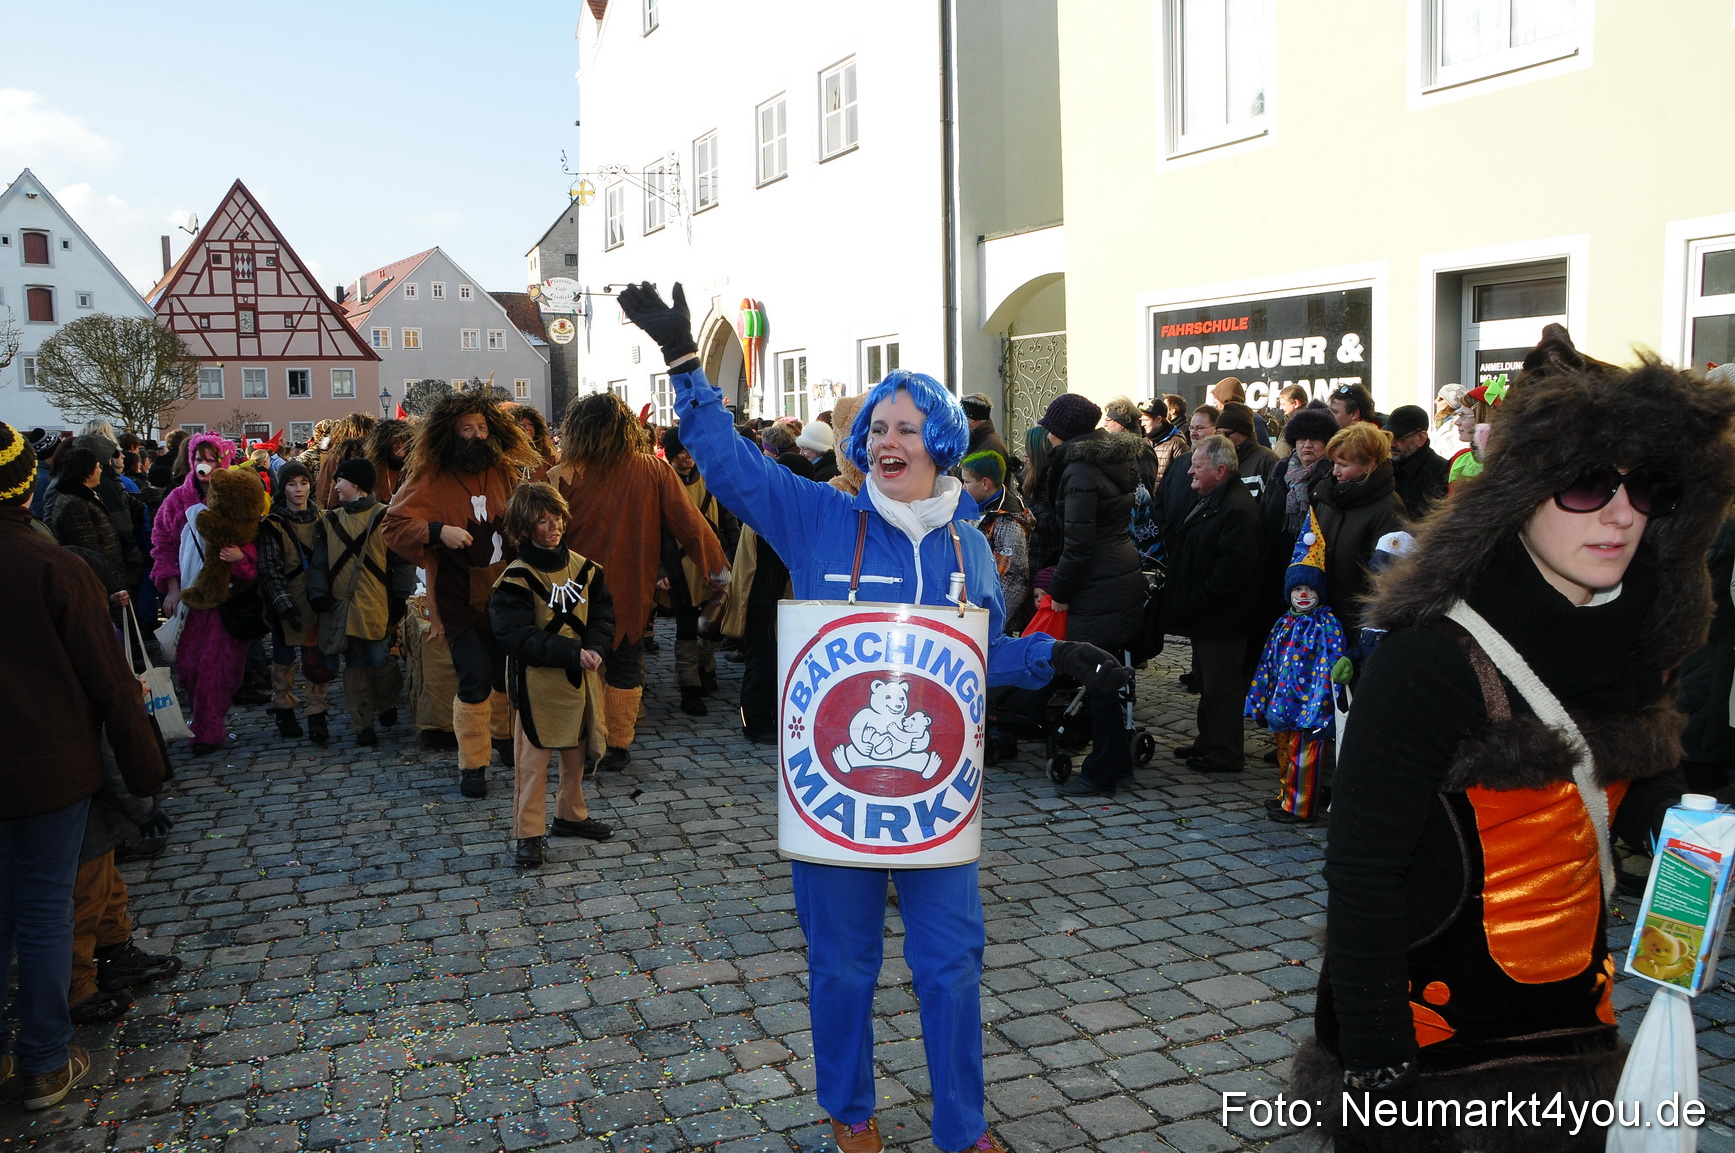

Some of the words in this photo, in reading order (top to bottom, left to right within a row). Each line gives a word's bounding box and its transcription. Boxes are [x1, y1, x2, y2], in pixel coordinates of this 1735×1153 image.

[1160, 317, 1250, 337] FAHRSCHULE
[1160, 336, 1328, 375] HOFBAUER
[1336, 332, 1365, 364] &
[1205, 376, 1362, 410] CHAN
[790, 631, 985, 725] BÄRCHINGS
[788, 746, 981, 843] MARKE
